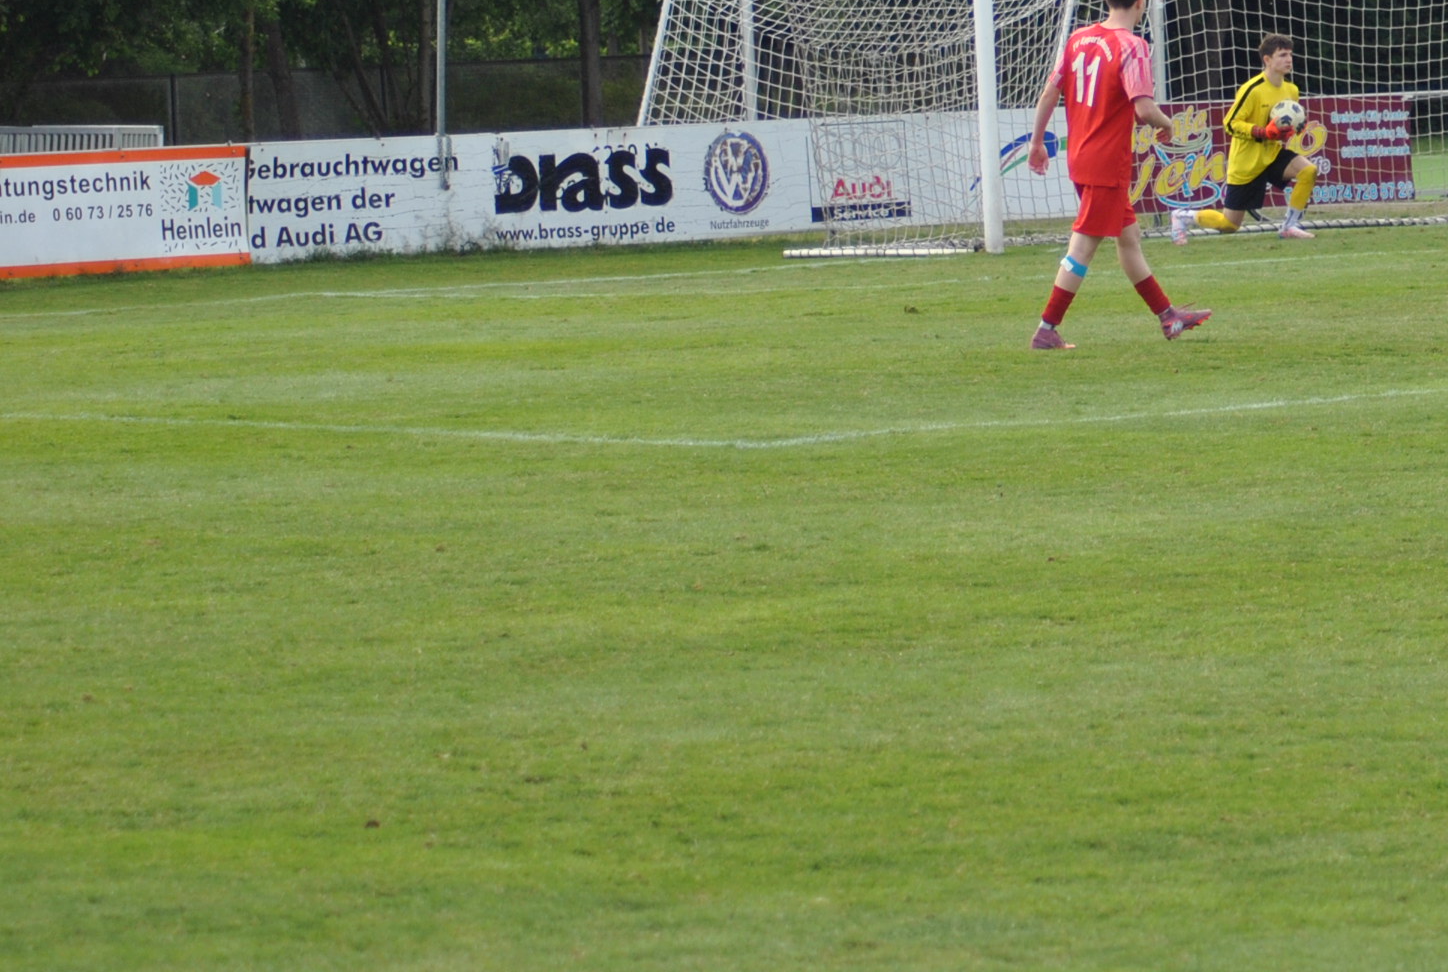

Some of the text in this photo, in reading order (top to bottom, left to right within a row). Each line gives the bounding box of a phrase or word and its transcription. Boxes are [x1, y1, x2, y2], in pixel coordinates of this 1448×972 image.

[0, 170, 151, 201] tungstechnik
[831, 175, 893, 200] Audi
[351, 187, 396, 210] der
[53, 208, 60, 221] 0
[66, 207, 82, 221] 60
[88, 206, 104, 219] 73
[117, 204, 133, 218] 25
[137, 203, 153, 217] 76
[710, 218, 770, 230] Nutzfahrzeuge
[161, 215, 242, 241] Heinlein
[276, 223, 335, 248] Audi
[344, 222, 383, 244] AG
